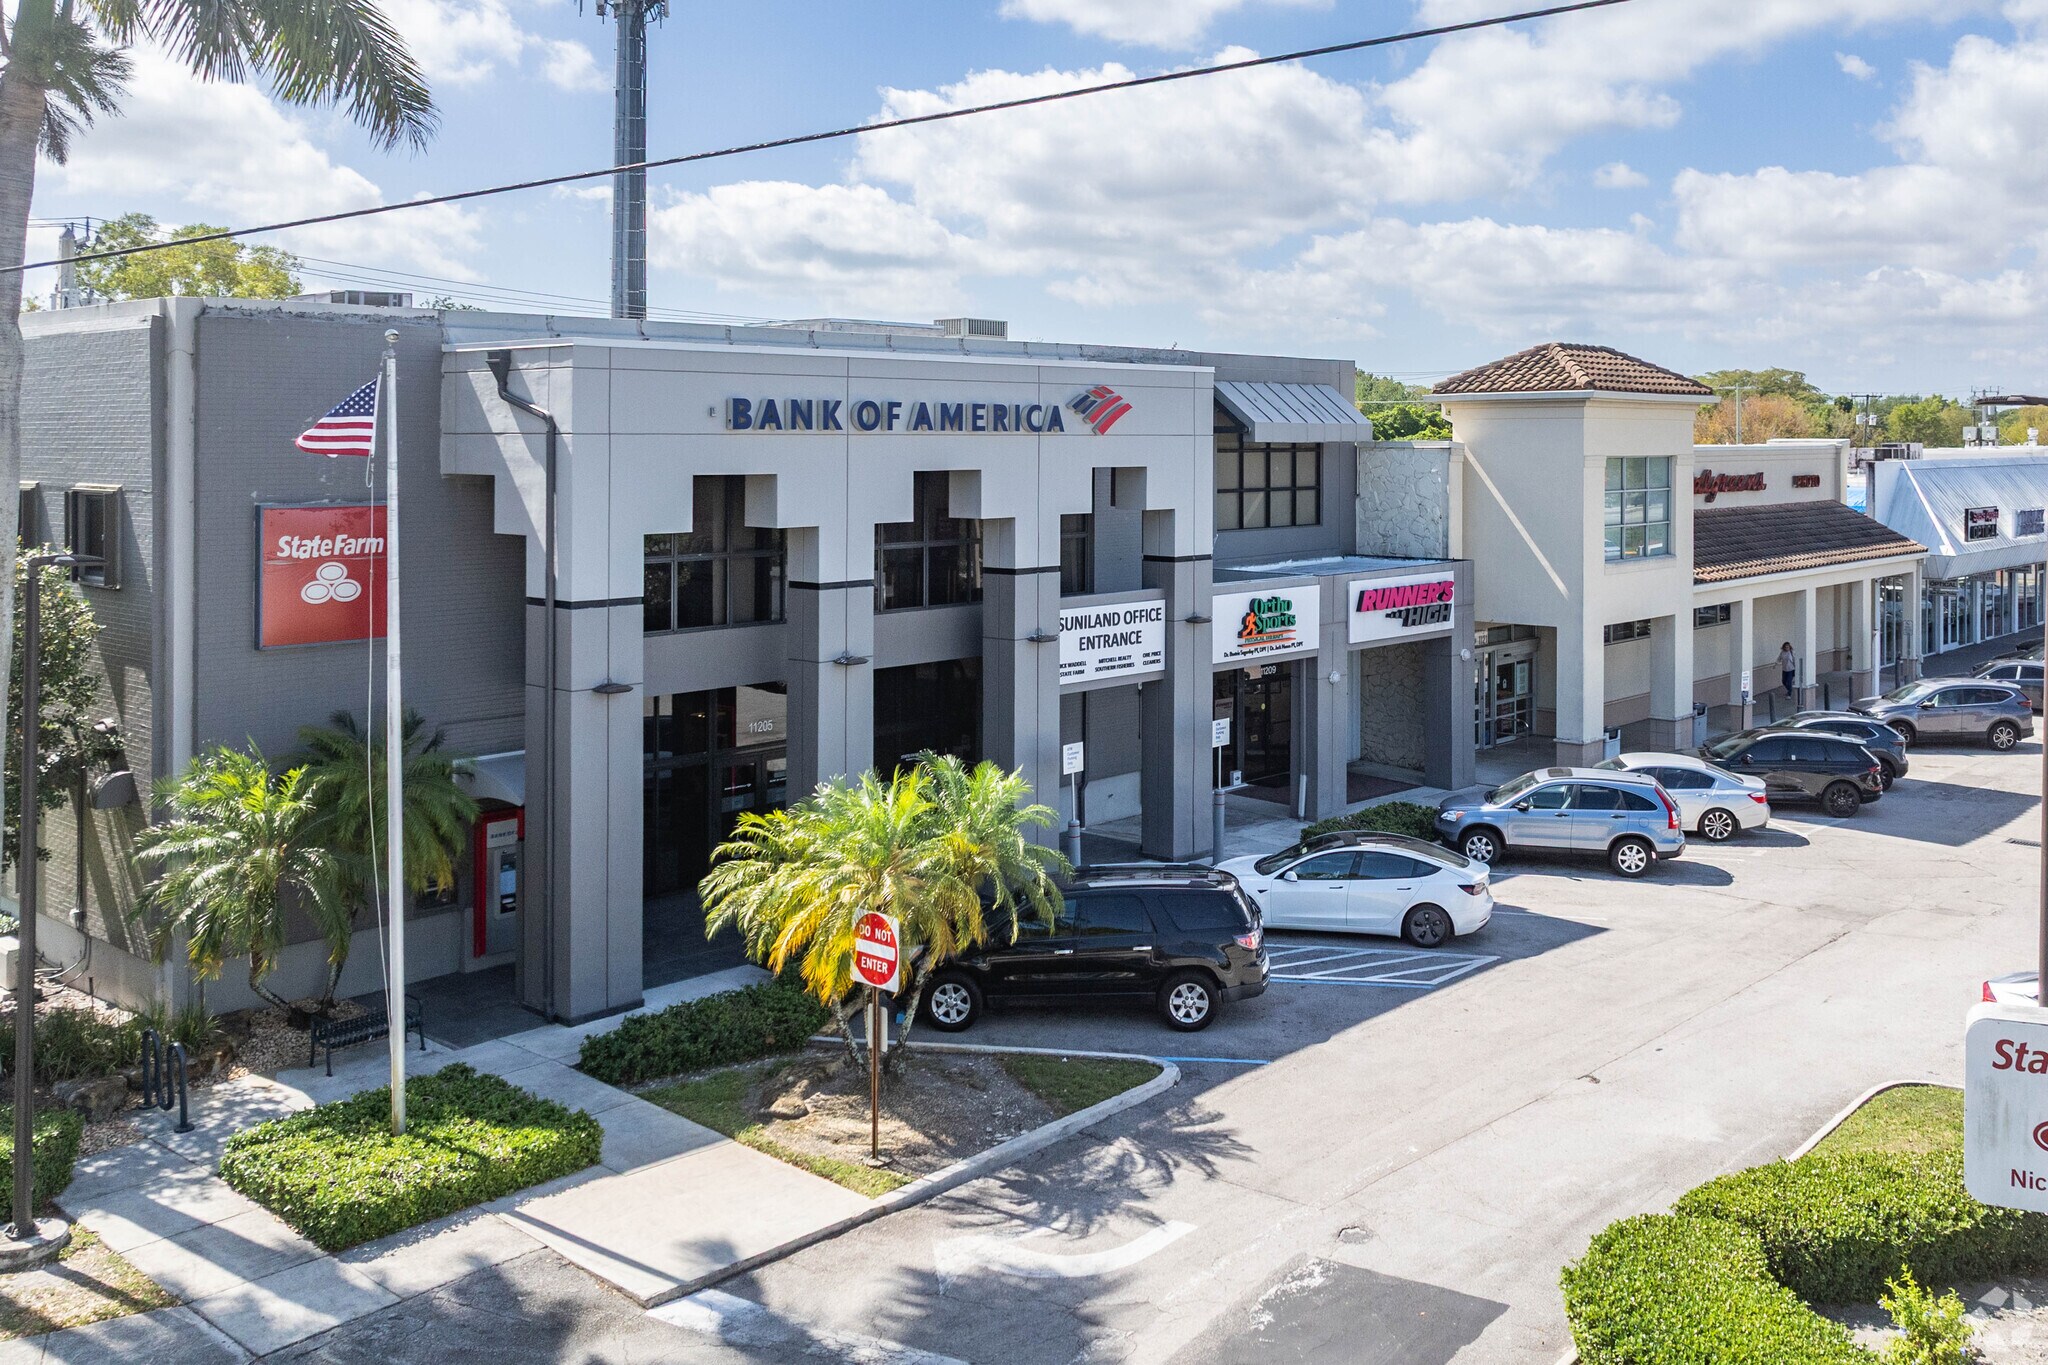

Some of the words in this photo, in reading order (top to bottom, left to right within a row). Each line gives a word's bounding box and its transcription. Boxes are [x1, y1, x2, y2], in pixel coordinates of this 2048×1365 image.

[729, 398, 843, 431] BANK
[854, 400, 902, 431] OF
[910, 401, 1066, 433] AMERICA
[1250, 596, 1293, 615] Ortho
[1357, 581, 1455, 612] RUNNER'S
[1059, 611, 1121, 633] SUNILAND
[1123, 607, 1162, 625] OFFICE
[1253, 613, 1296, 634] Sports
[1402, 604, 1452, 627] HIGH
[1079, 630, 1142, 651] ENTRANCE
[1094, 664, 1116, 672] SOUTHERN
[1098, 656, 1117, 664] MITCHELL
[749, 719, 773, 733] 11205
[859, 924, 871, 937] DO
[875, 928, 892, 943] NOT
[861, 956, 888, 975] ENTER
[2011, 1168, 2047, 1191] Nic
